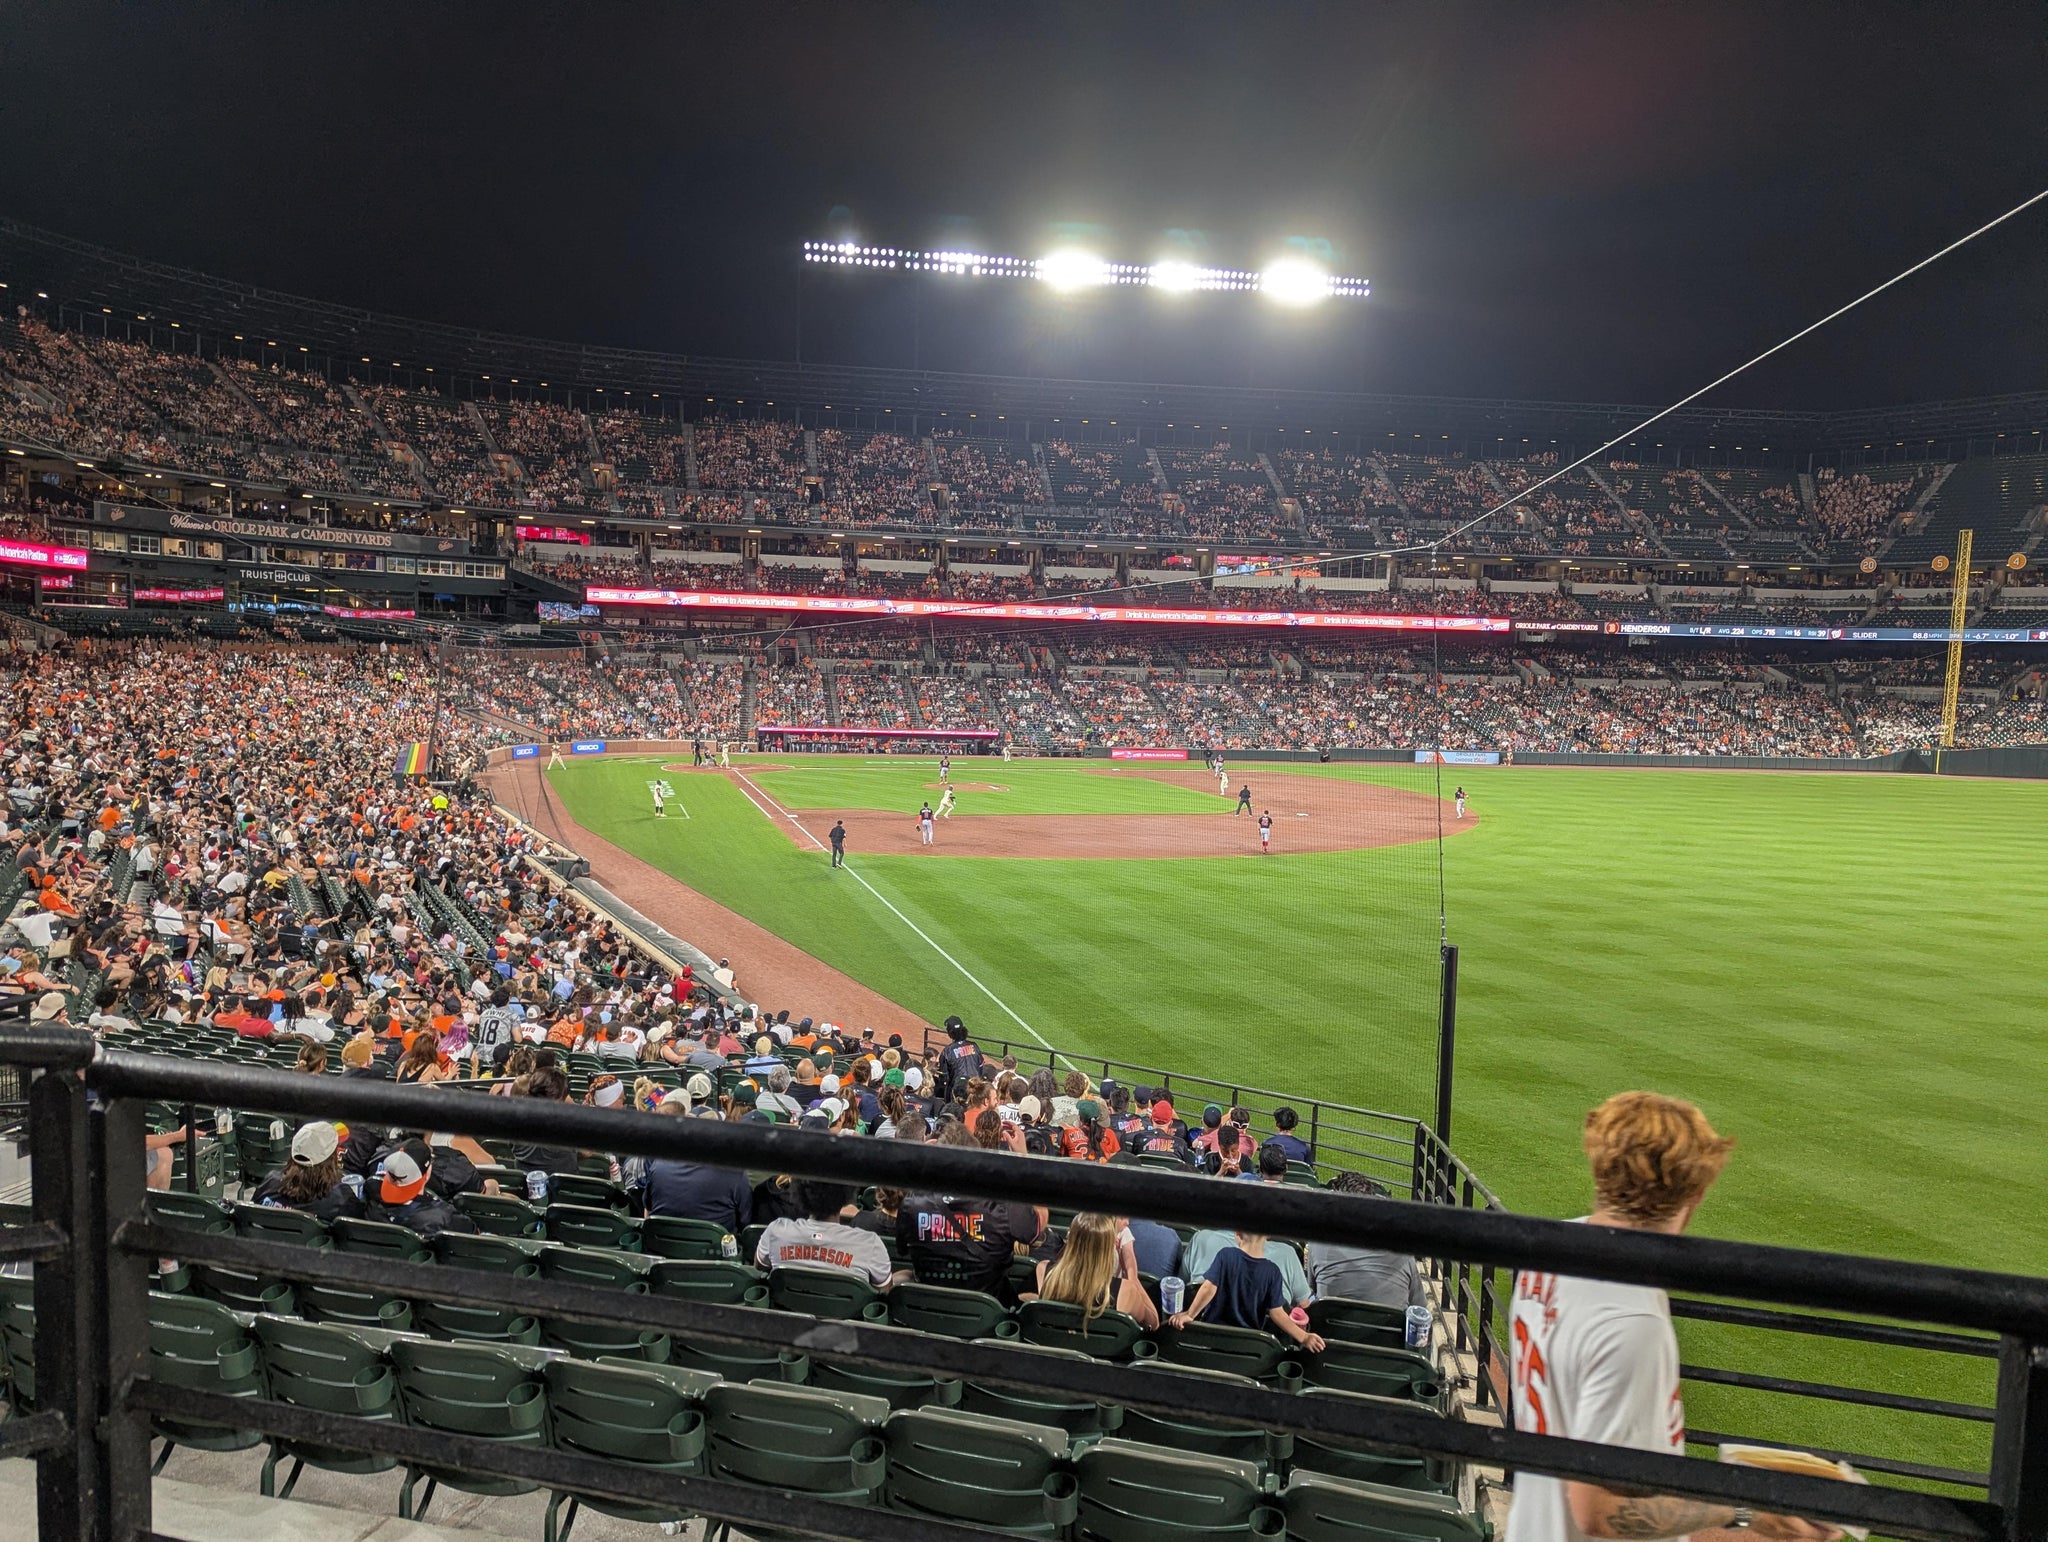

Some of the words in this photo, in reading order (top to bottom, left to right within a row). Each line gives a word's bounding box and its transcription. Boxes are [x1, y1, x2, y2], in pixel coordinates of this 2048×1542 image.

[169, 514, 204, 530] Welcome
[204, 522, 212, 531] to
[211, 520, 257, 535] ORIOLE
[257, 525, 289, 538] PARK
[300, 528, 353, 543] CAMDEN
[352, 533, 392, 547] YARDS
[28, 549, 48, 562] Pastime
[1862, 561, 1875, 570] 20
[240, 569, 274, 580] TRUIST
[287, 573, 311, 582] CLUB
[710, 596, 729, 604] Drink
[737, 596, 770, 605] America's
[770, 598, 798, 607] Pastime
[923, 604, 942, 612] Drink
[1125, 611, 1143, 619] Drink
[1181, 613, 1207, 621] Pastime
[1323, 616, 1341, 624] Drink
[1378, 618, 1404, 626] Pastime
[1536, 622, 1551, 630] PARK
[1556, 623, 1581, 631] CAMDEN
[1620, 625, 1670, 634] HENDERSON
[1699, 627, 1712, 635] L/R
[1793, 629, 1801, 637] 16
[516, 748, 533, 756] GEICO
[480, 1019, 500, 1045] 18
[1117, 1118, 1145, 1134] PRIDE
[1142, 1137, 1175, 1153] PRIDE
[779, 1245, 854, 1268] HENDERSON
